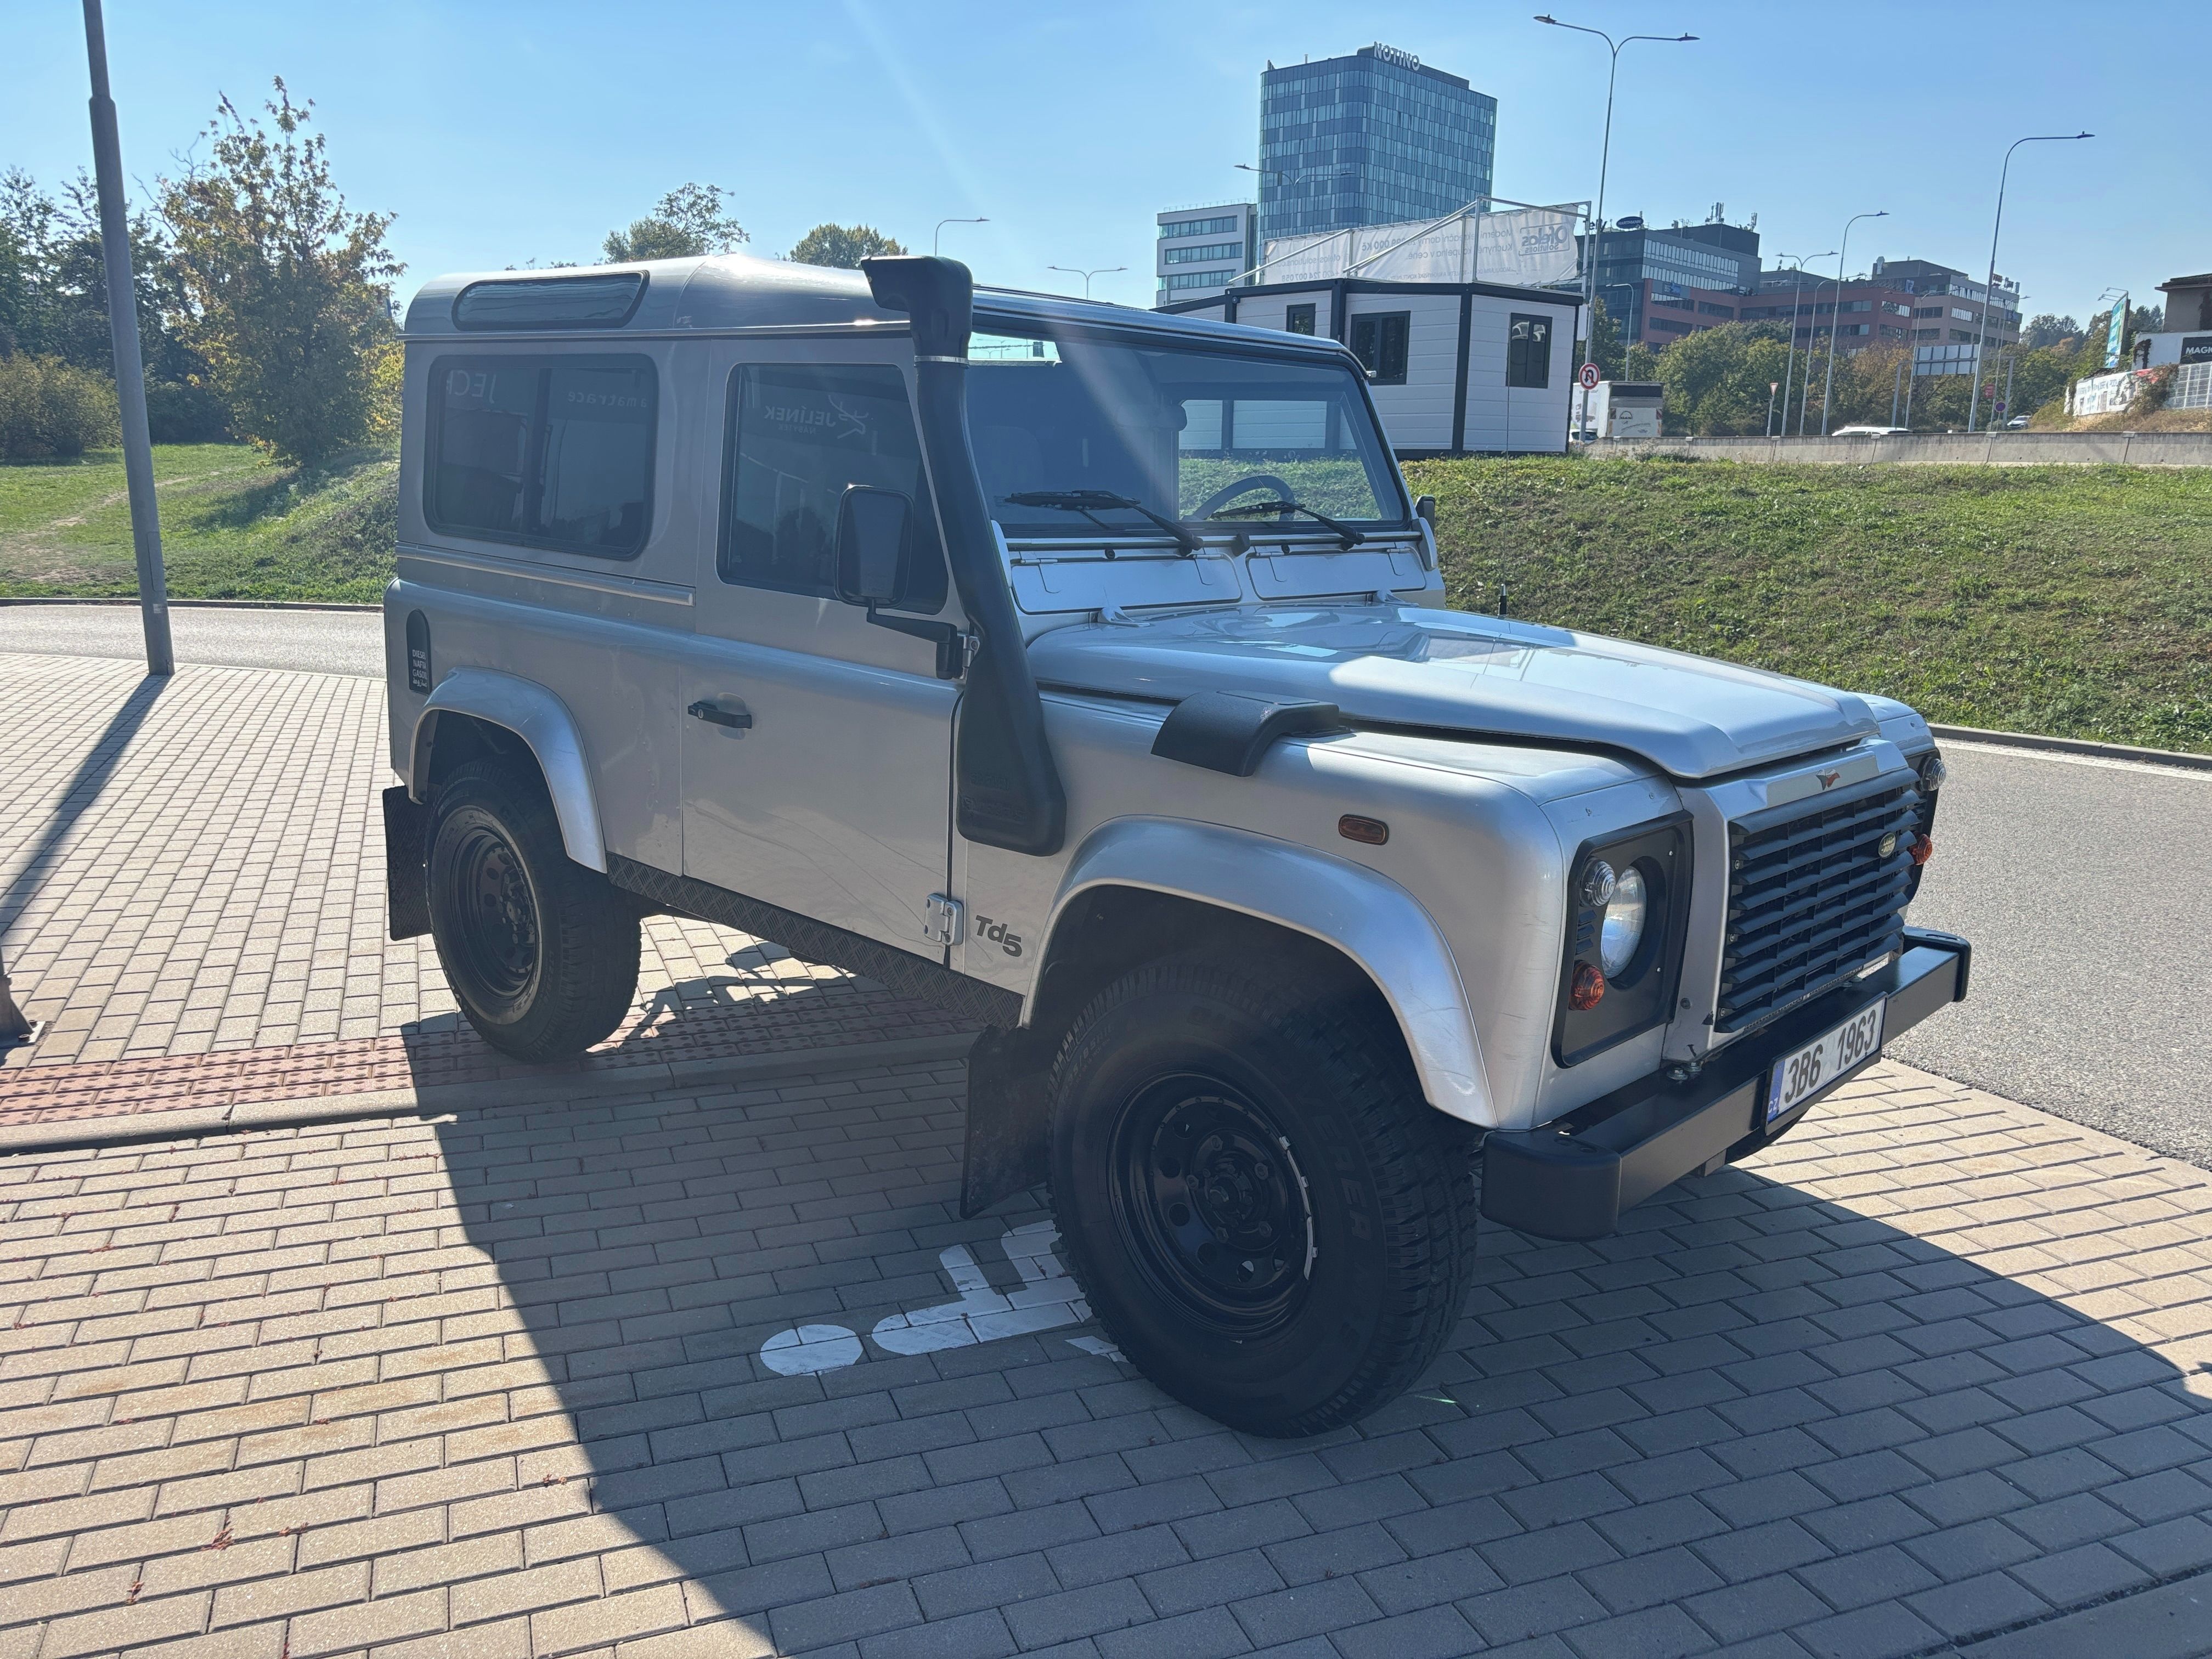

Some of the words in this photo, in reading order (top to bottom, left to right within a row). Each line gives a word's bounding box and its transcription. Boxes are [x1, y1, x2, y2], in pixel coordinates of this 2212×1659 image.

[1374, 41, 1420, 71] NOTINO
[2186, 346, 2212, 355] MAGI
[413, 649, 426, 660] DIESEL
[413, 659, 426, 670] NAFTA
[413, 669, 427, 680] GASOIL
[975, 915, 1023, 957] Td5
[1785, 1044, 1823, 1104] 3B6
[1838, 1009, 1876, 1070] 1963
[1768, 1097, 1779, 1114] CZ
